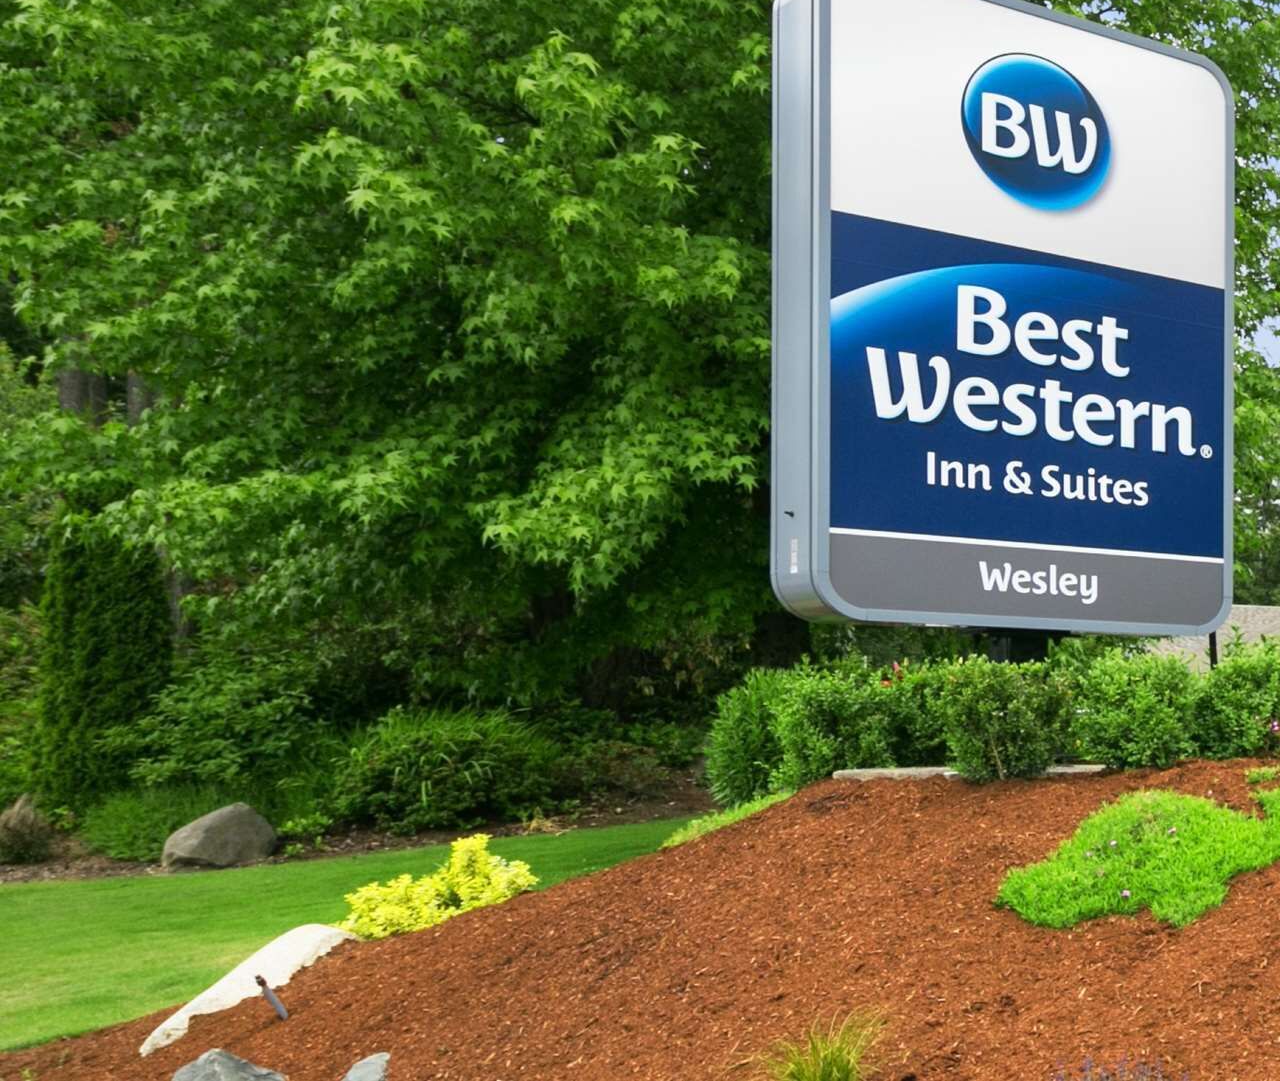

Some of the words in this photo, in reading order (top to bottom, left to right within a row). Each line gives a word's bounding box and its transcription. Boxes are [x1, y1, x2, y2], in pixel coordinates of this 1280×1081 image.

[981, 92, 1098, 174] BW
[956, 285, 1130, 377] Best
[926, 451, 992, 491] Inn
[1003, 460, 1034, 495] &
[1041, 464, 1149, 506] Suites
[978, 560, 1099, 605] Wesley
